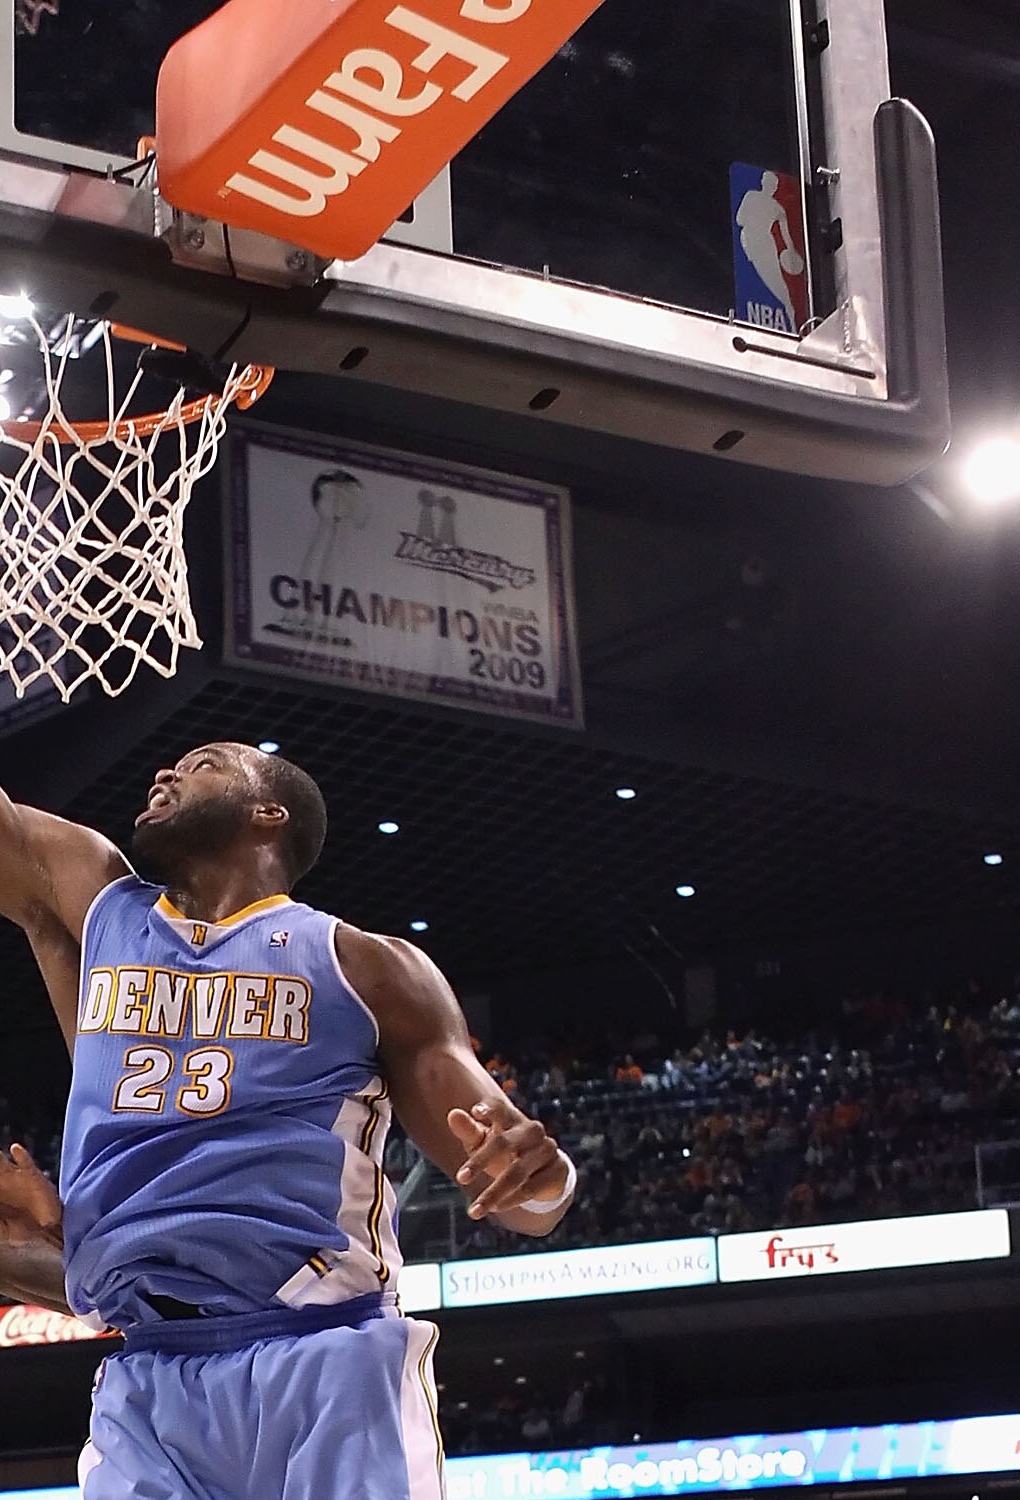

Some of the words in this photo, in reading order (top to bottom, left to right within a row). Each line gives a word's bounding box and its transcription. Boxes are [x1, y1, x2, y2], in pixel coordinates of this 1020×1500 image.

[226, 5, 509, 217] Farm
[747, 301, 787, 331] NBA
[270, 574, 542, 657] CHAMPIONS
[470, 648, 546, 690] 2009
[78, 966, 312, 1044] DENVER
[112, 1044, 235, 1118] 23
[498, 1459, 568, 1497] The
[581, 1447, 806, 1493] RoomStore
